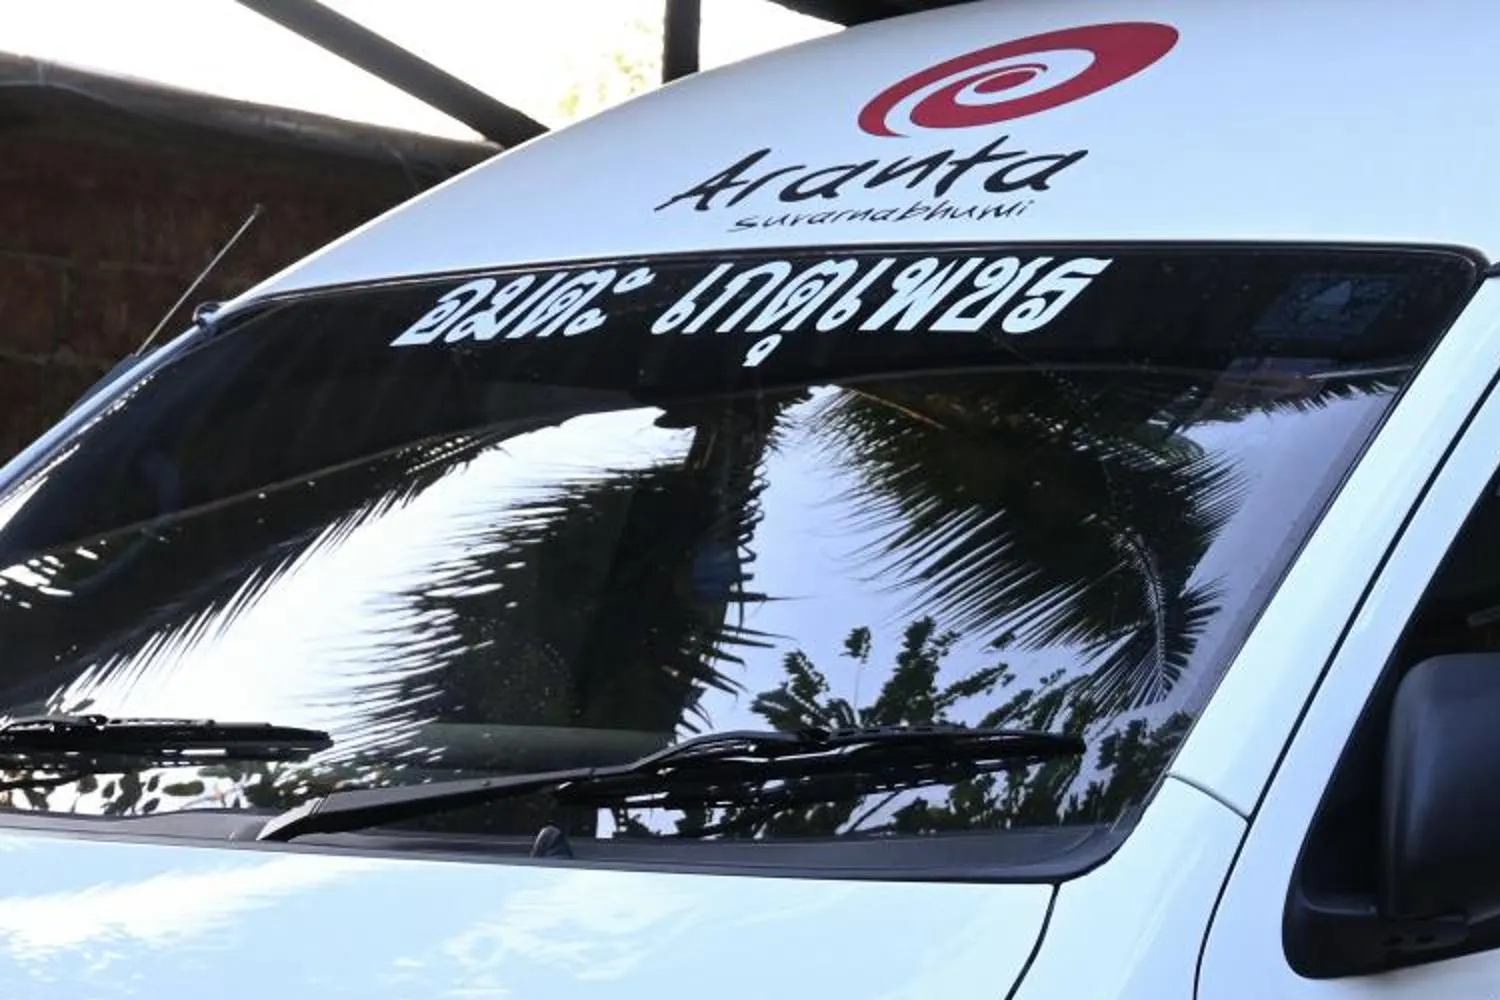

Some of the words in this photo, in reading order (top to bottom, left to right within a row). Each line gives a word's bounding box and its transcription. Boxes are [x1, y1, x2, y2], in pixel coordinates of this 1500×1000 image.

[653, 134, 1090, 212] Aranta
[726, 199, 1036, 233] suvarnabhumi
[388, 265, 658, 348] อมตะ
[650, 254, 1115, 368] เกตุเพชร
